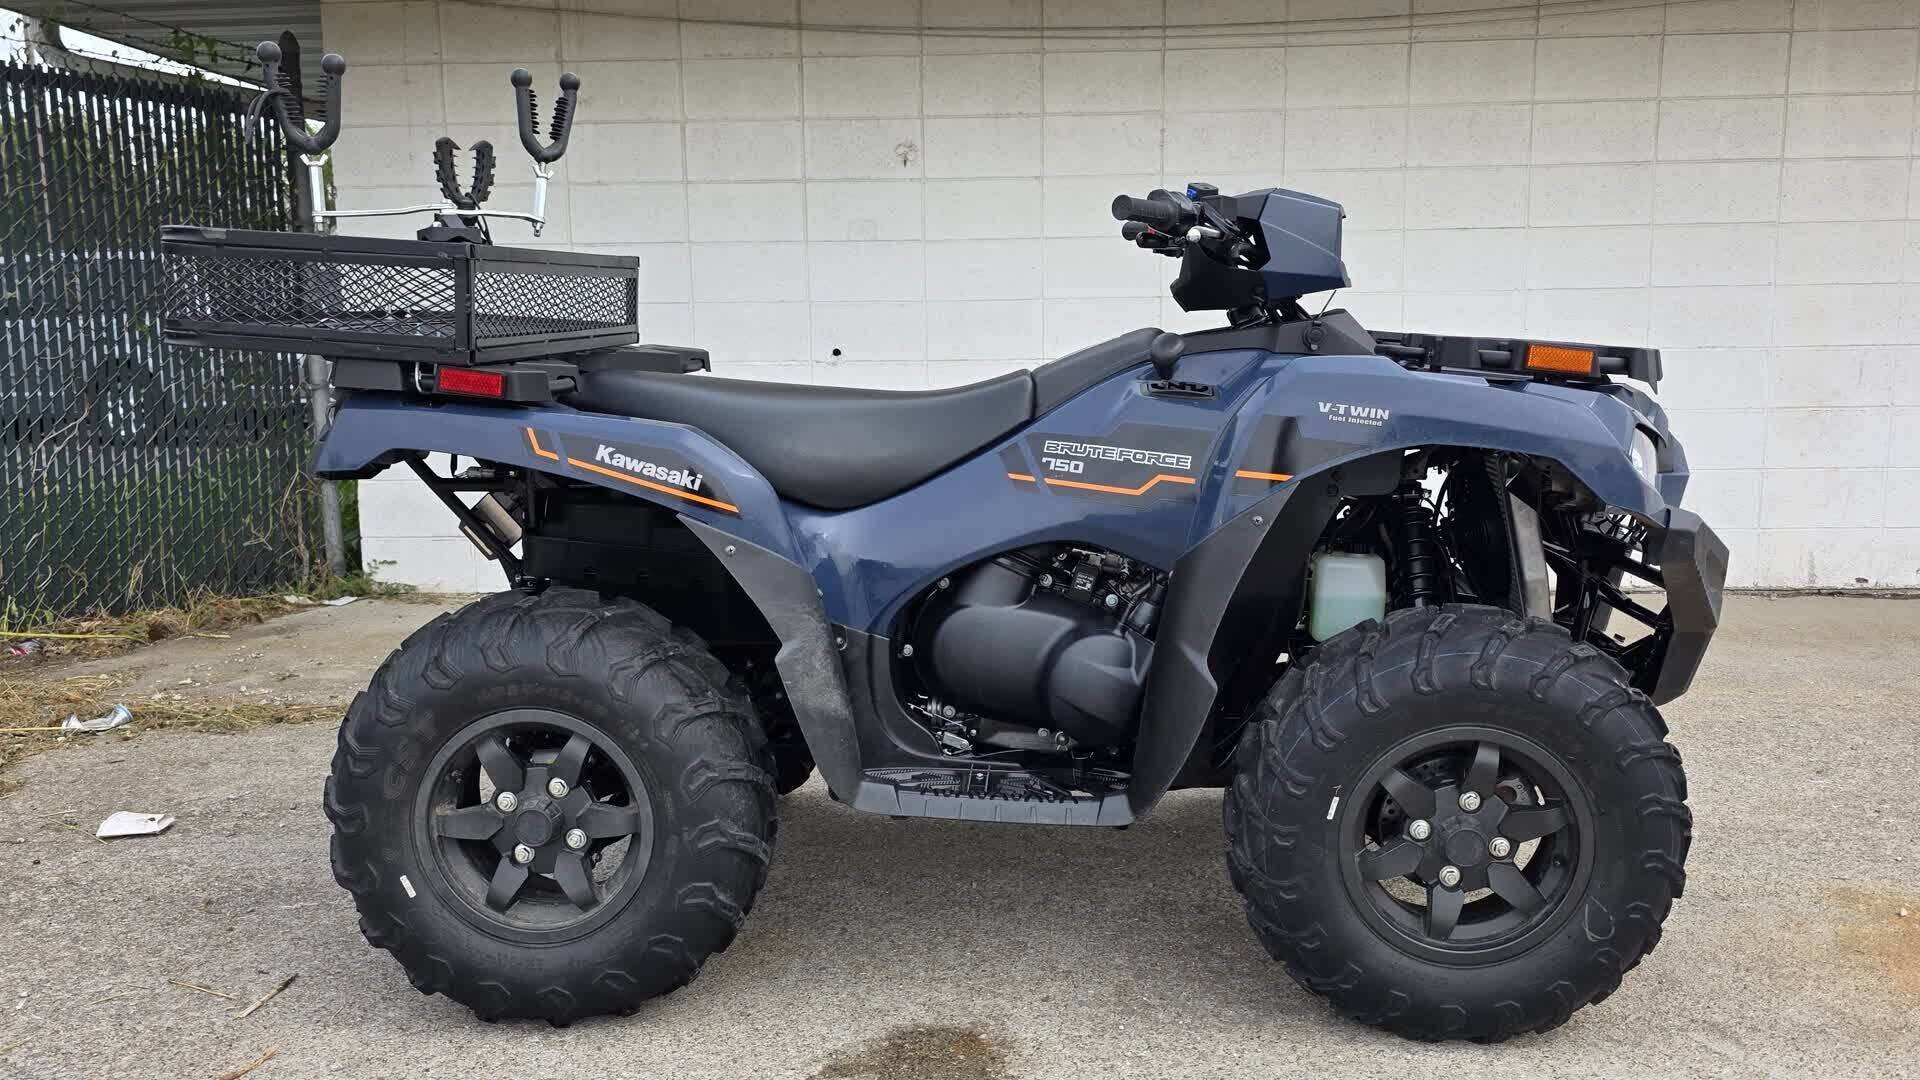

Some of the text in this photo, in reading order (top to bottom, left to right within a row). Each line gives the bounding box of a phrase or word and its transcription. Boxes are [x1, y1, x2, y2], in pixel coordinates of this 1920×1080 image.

[1318, 401, 1389, 420] V-TWIN
[1328, 414, 1382, 426] Fuel Injected
[595, 444, 703, 491] Kawasaki
[1041, 457, 1085, 474] 750
